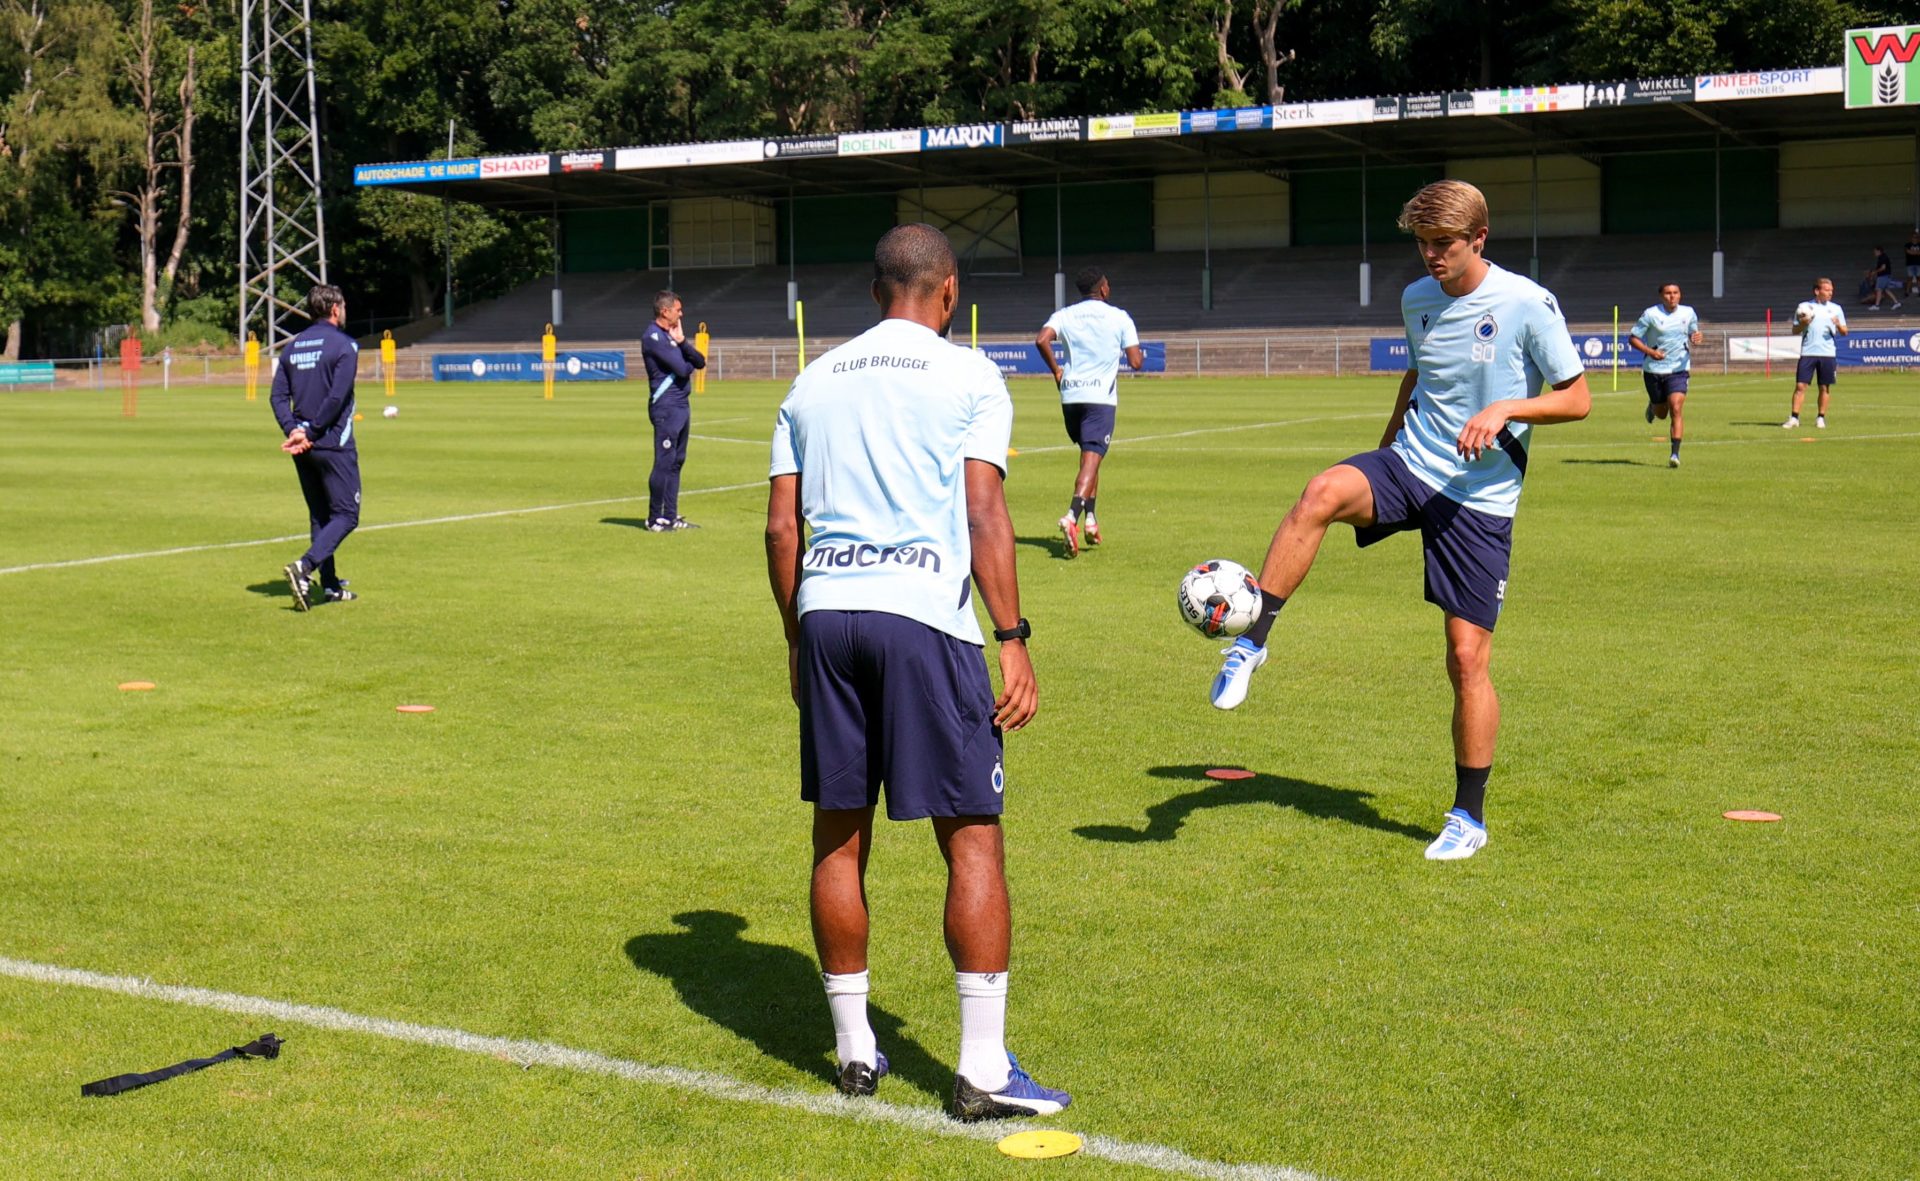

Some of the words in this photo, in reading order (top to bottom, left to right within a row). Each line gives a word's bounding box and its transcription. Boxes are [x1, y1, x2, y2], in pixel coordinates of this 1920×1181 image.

[1639, 78, 1687, 91] WIKKEL
[1712, 70, 1811, 88] INTERSPORT
[1736, 84, 1785, 96] WINNERS
[1274, 103, 1315, 121] Sterk
[1012, 119, 1080, 135] HOLLANDICA
[926, 124, 996, 148] MARIN
[482, 157, 548, 174] SHARP
[357, 167, 425, 182] AUTOSCHADE
[1849, 338, 1906, 349] FLETCHER
[988, 351, 1027, 360] FOOTBALL
[832, 357, 867, 374] CLUB
[871, 355, 931, 371] BRUGGE
[805, 543, 941, 573] macron
